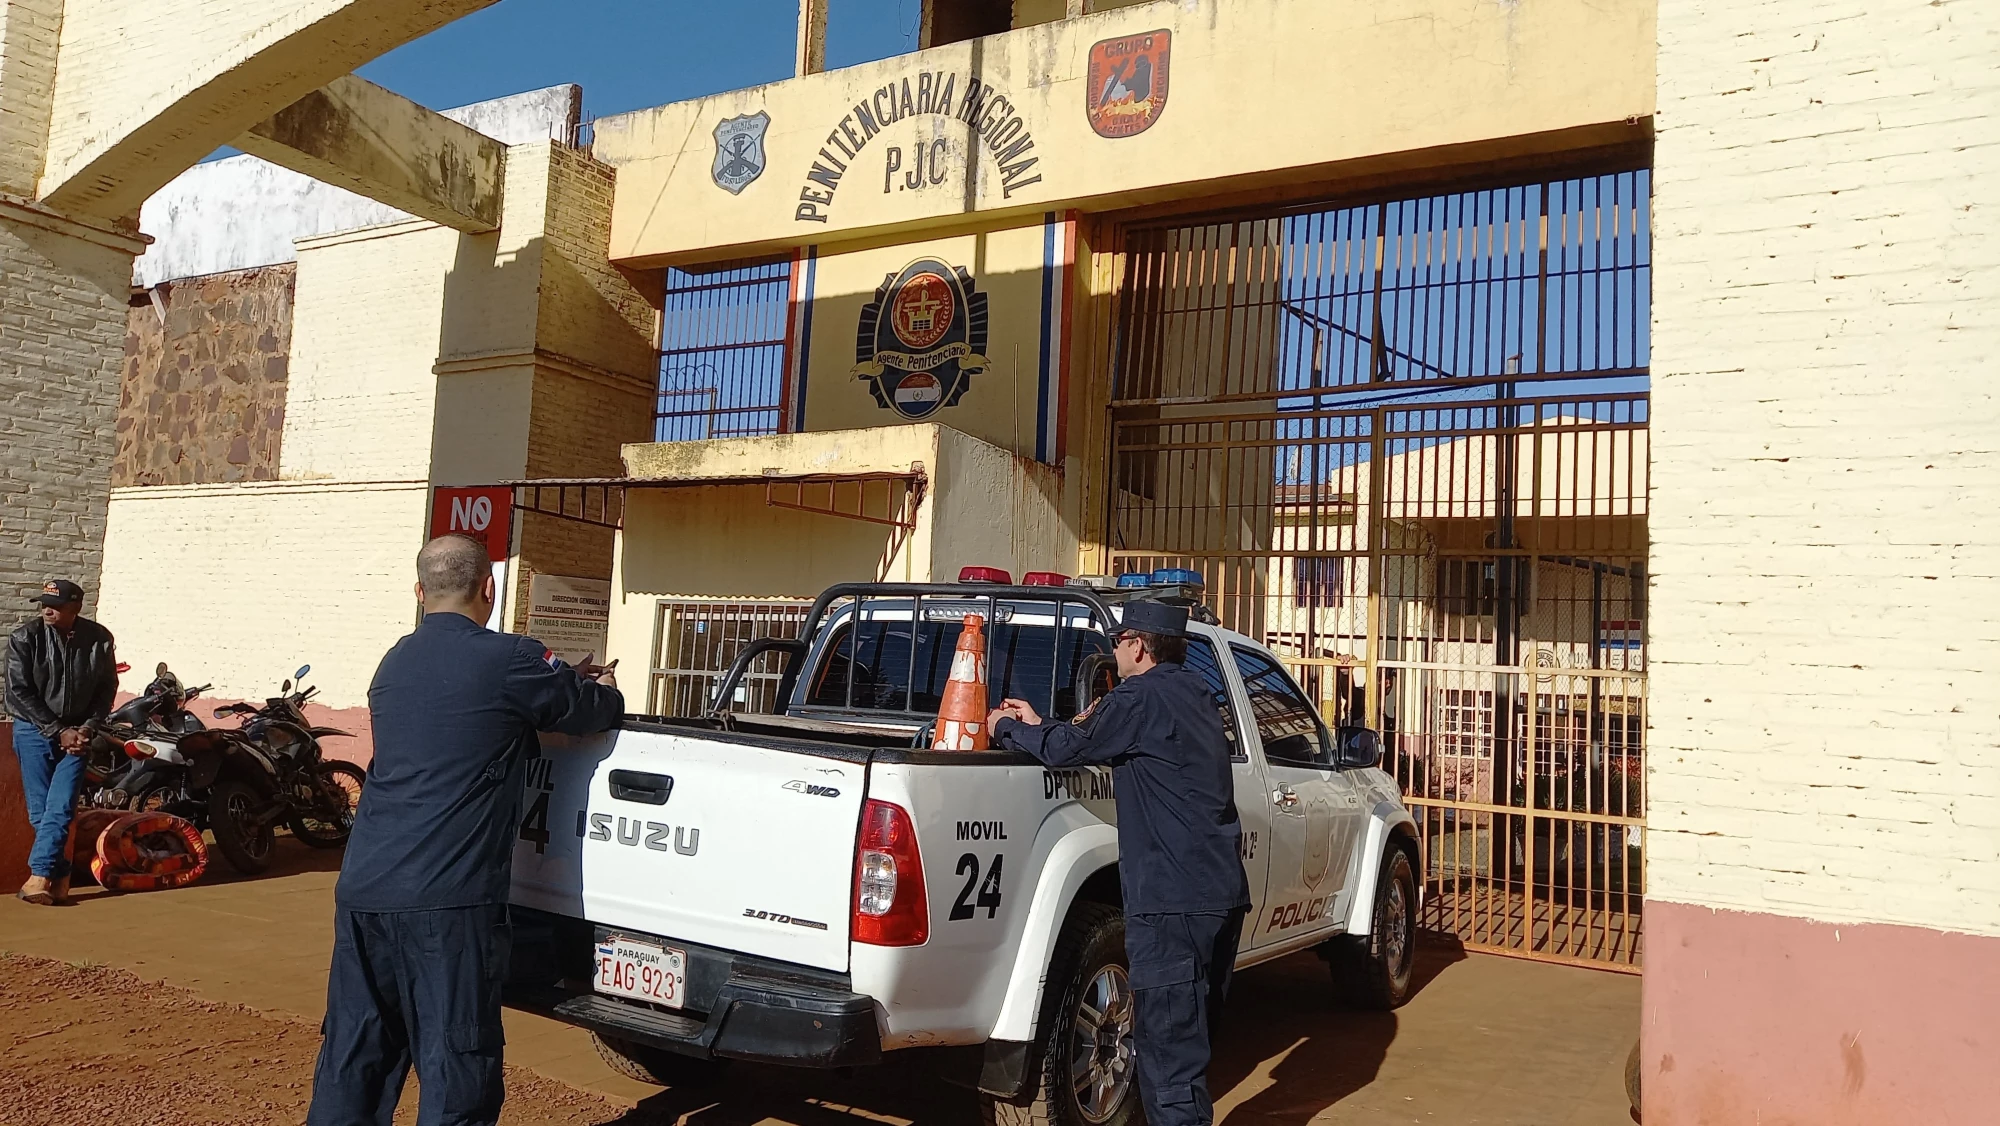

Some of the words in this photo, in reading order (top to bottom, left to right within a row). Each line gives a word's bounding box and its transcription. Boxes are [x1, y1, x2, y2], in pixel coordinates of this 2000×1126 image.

[1105, 37, 1153, 58] GRUPO
[795, 72, 956, 223] PENITENCIARIA
[956, 78, 1042, 199] REGIONAL
[877, 354, 903, 367] Agente
[907, 345, 966, 369] Penitenciario
[450, 496, 492, 531] NO
[534, 618, 559, 627] NORMAS
[561, 620, 592, 630] GENERALES
[594, 622, 602, 630] DE
[782, 780, 841, 798] 4WD
[1043, 770, 1087, 800] DPTO.
[520, 792, 550, 854] 4
[576, 810, 700, 857] ISUZU
[956, 821, 1007, 841] MOVIL
[948, 853, 1003, 921] 24
[1266, 894, 1338, 933] POLICIA
[617, 948, 660, 964] PARAGUAY
[601, 957, 635, 990] EAG
[642, 966, 675, 999] 923
